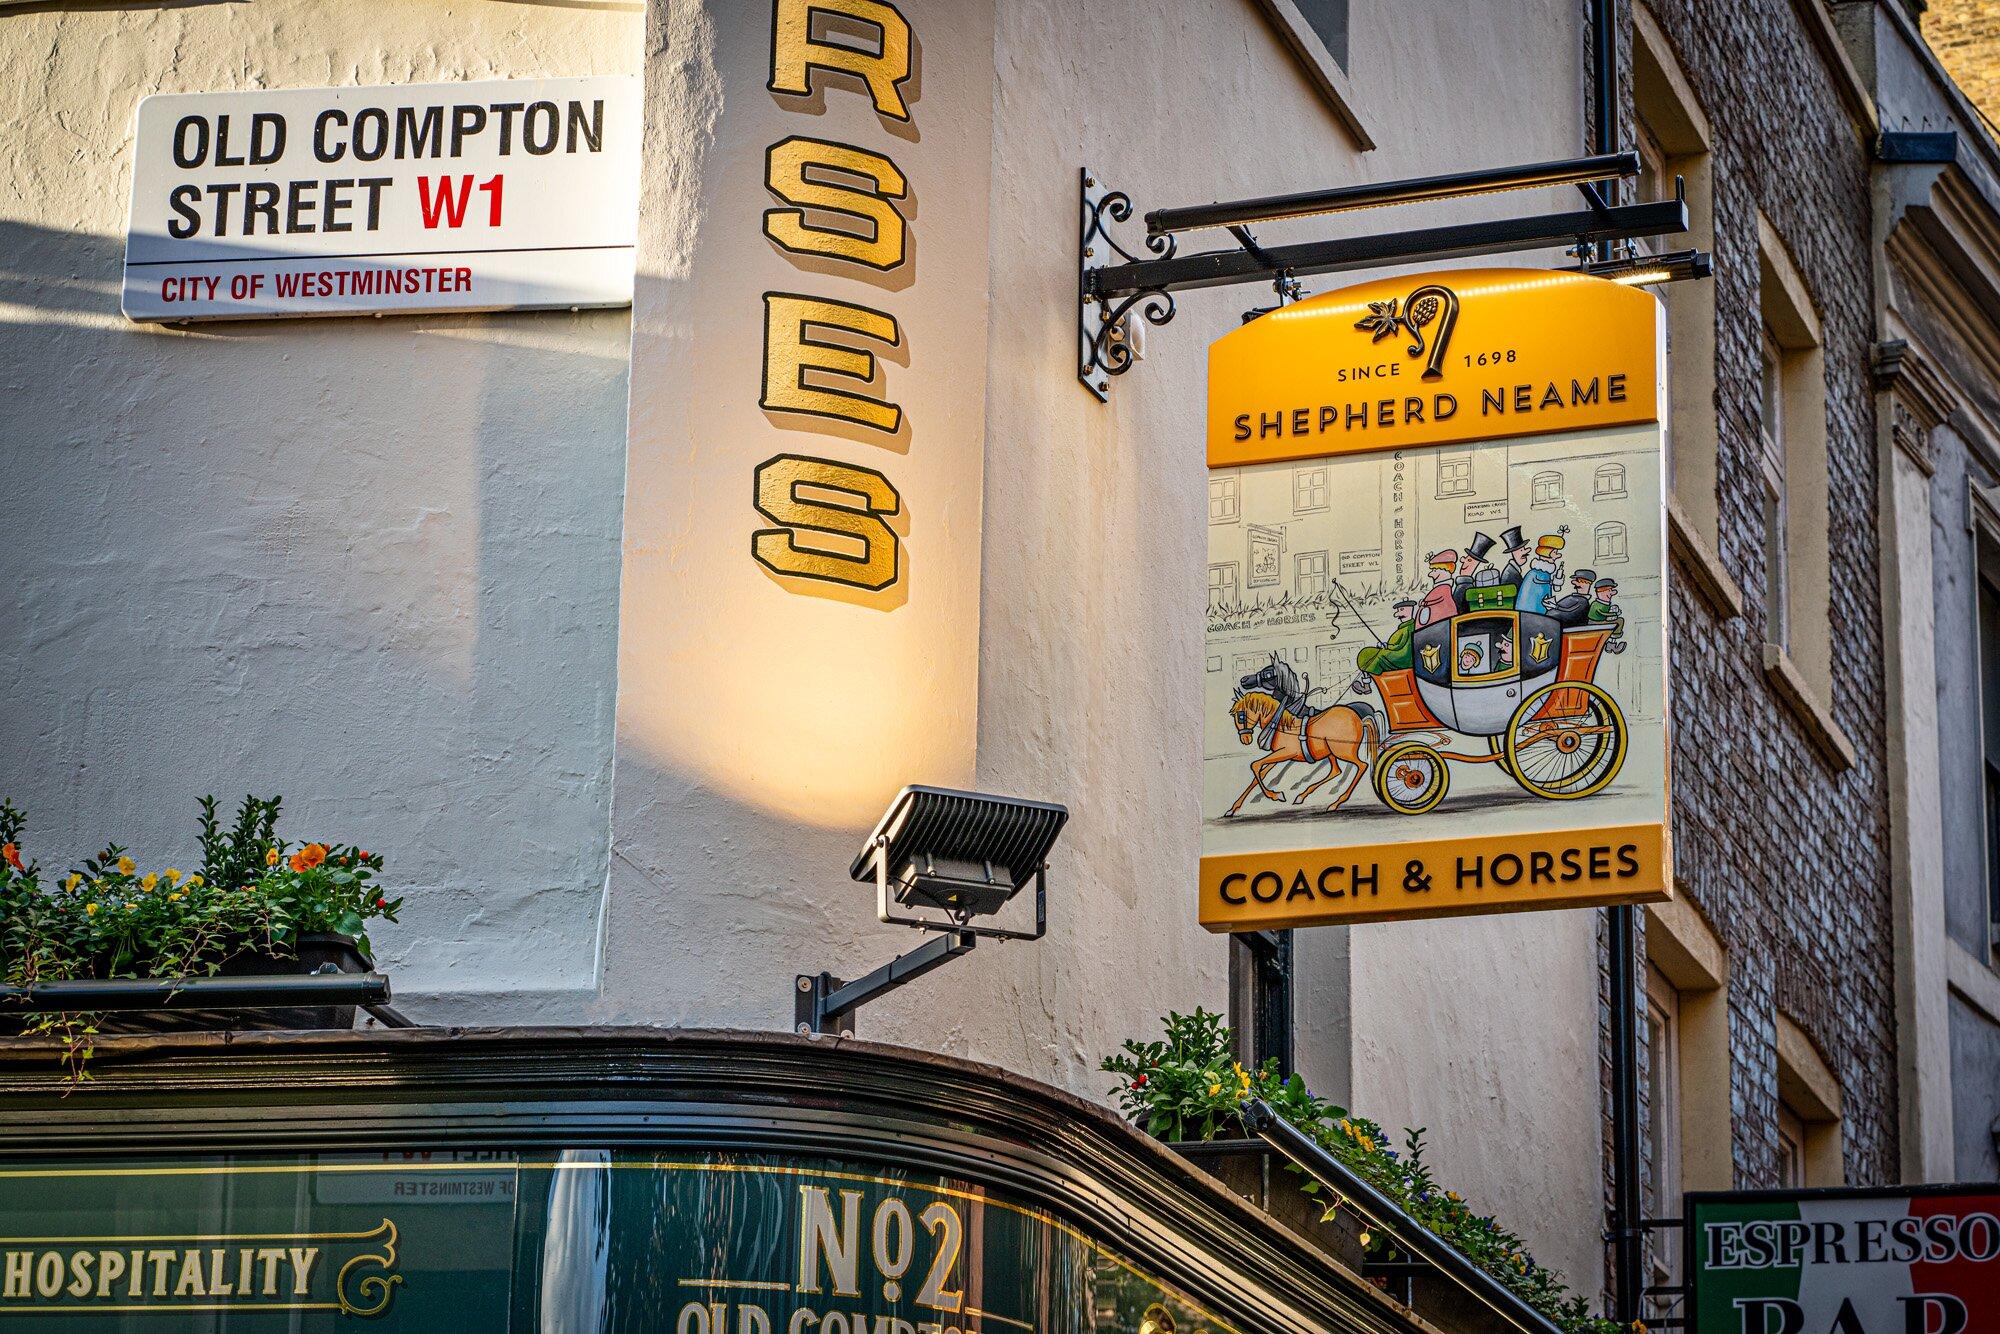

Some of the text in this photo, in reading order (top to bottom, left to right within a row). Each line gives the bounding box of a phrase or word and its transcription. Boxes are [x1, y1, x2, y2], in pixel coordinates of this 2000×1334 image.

[173, 99, 603, 169] OLD COMPTON
[168, 174, 502, 239] STREET W1
[162, 267, 472, 302] CITY OF WESTMINSTER
[1337, 349, 1517, 382] SINCE 1698
[1234, 373, 1628, 441] SHEPHERD NEAME
[1207, 621, 1251, 633] COACH
[1266, 613, 1316, 626] HORSES
[1219, 844, 1639, 905] COACH & HORSES
[1704, 1212, 2000, 1270] ESPRESSO
[2, 1247, 319, 1297] HOSPITALITY
